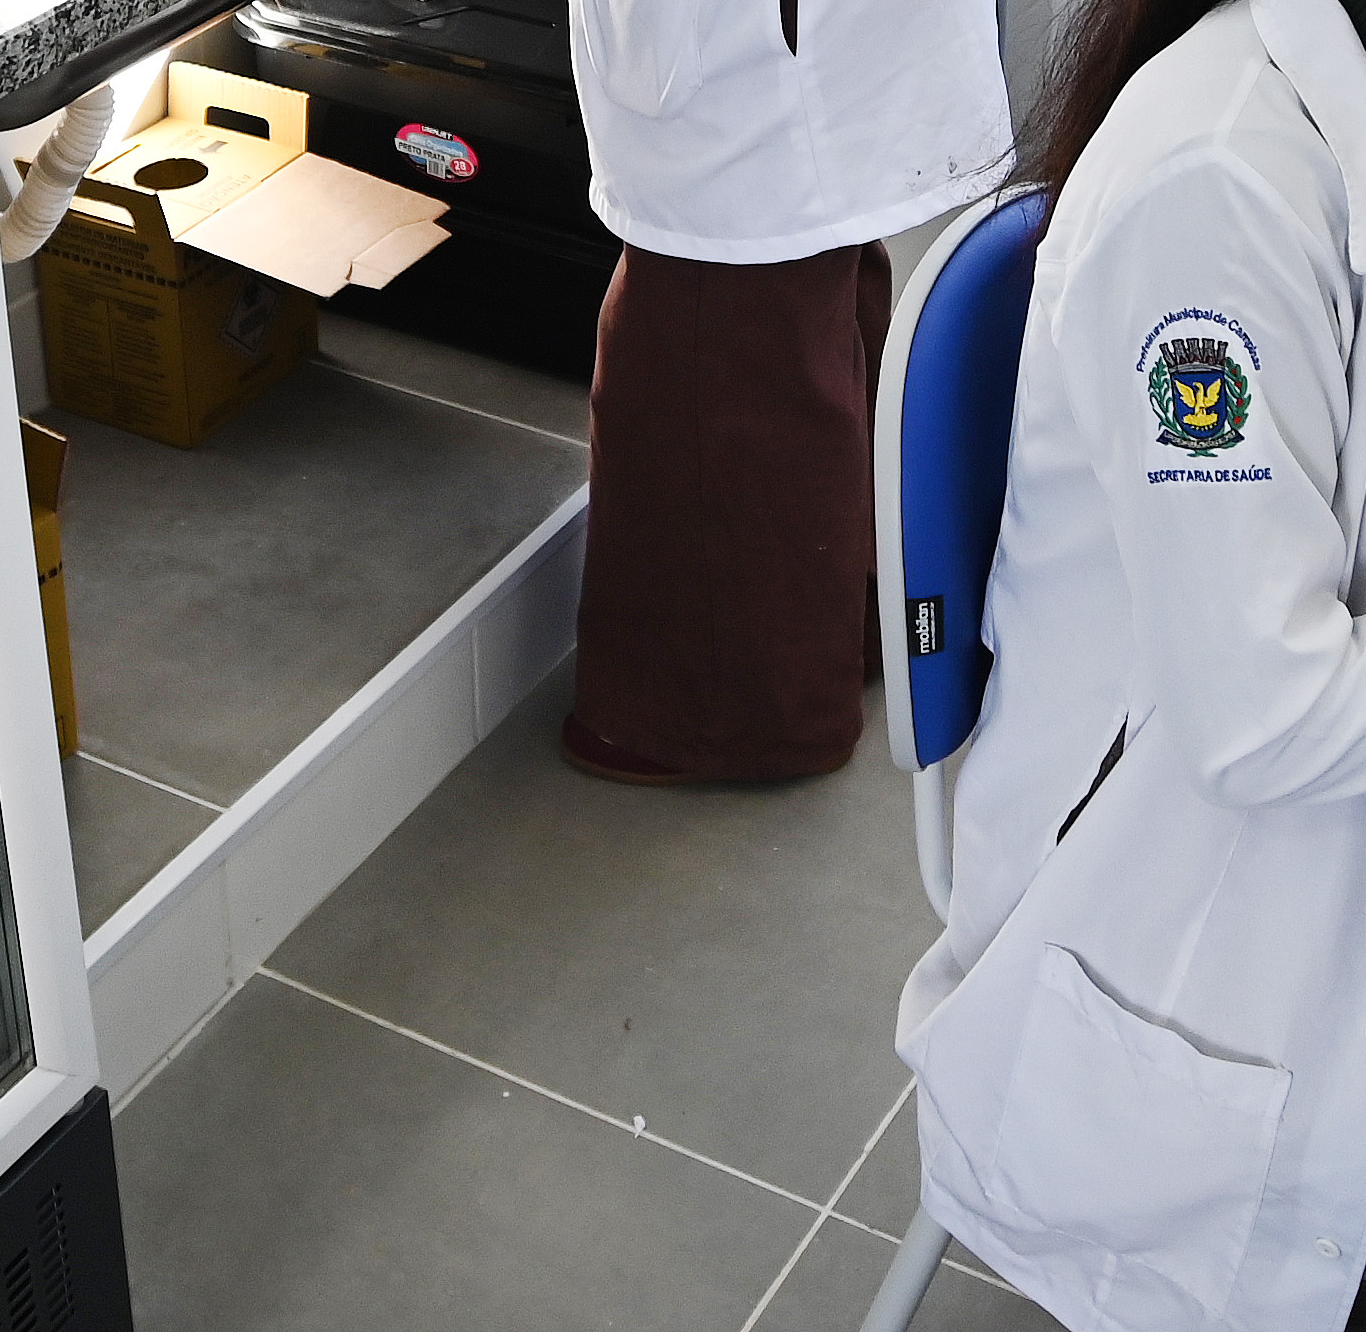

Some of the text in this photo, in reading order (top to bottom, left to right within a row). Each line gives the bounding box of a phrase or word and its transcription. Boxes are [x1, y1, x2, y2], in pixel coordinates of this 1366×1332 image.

[1136, 307, 1261, 373] Prefeitura Municipal de Campinas
[1147, 464, 1273, 485] SECRETARIA DE SAÚDE
